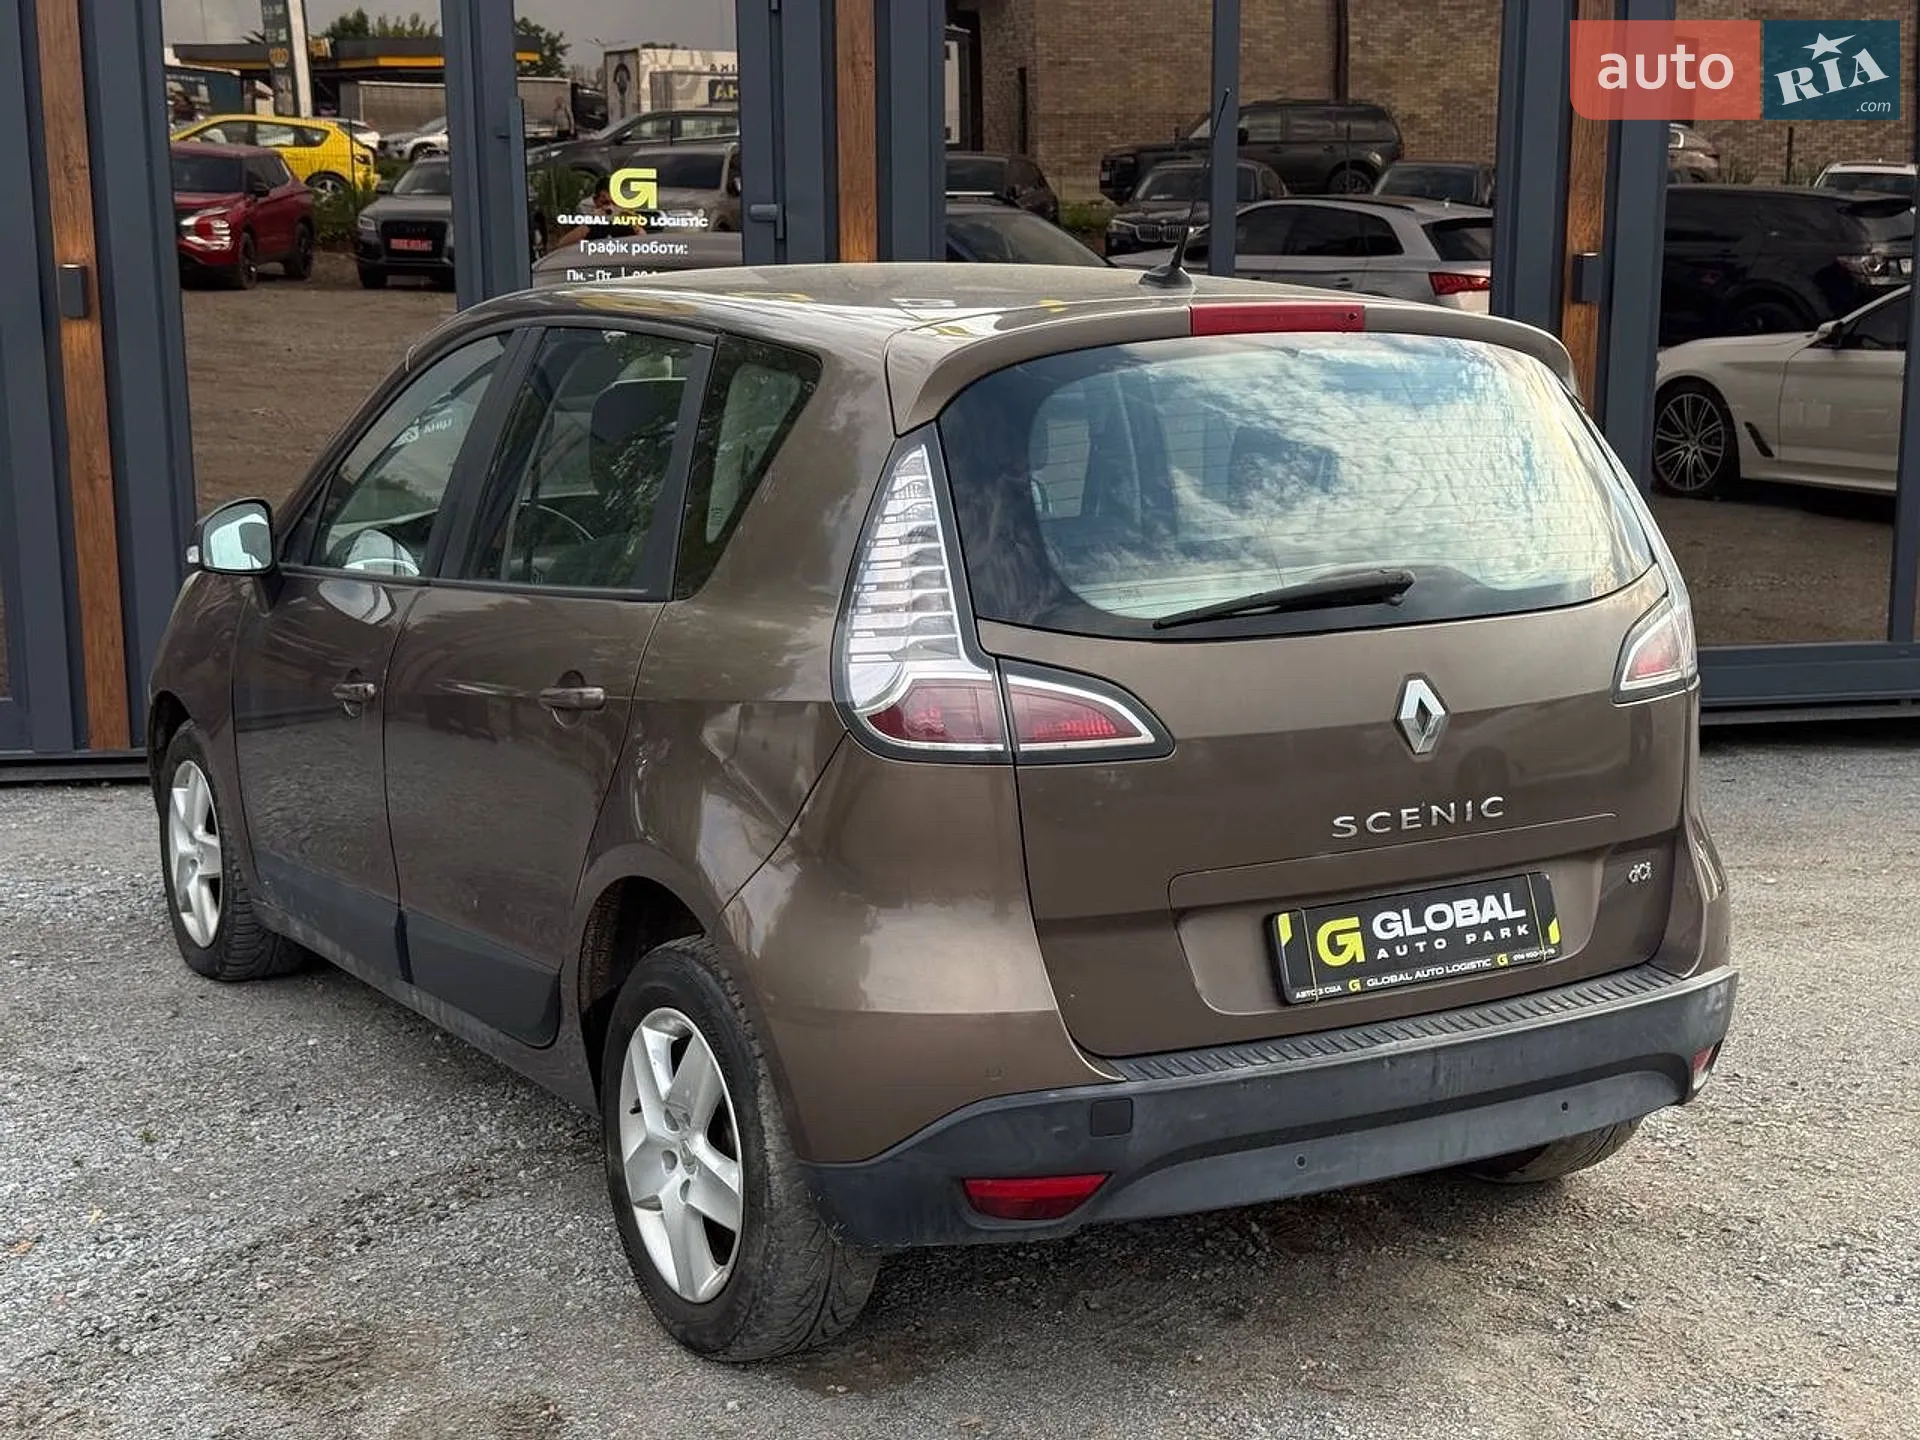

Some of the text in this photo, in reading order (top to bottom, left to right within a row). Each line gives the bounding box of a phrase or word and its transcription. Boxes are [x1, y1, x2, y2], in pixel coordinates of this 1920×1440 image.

[557, 214, 709, 228] GLOBAL AUTO LOGISTIC
[580, 240, 689, 256] Графік роботи:
[1372, 893, 1526, 940] GLOBAL
[1377, 923, 1529, 960] AUTO PARK
[1367, 958, 1492, 987] GLOBAL AUTO LOGISTIC
